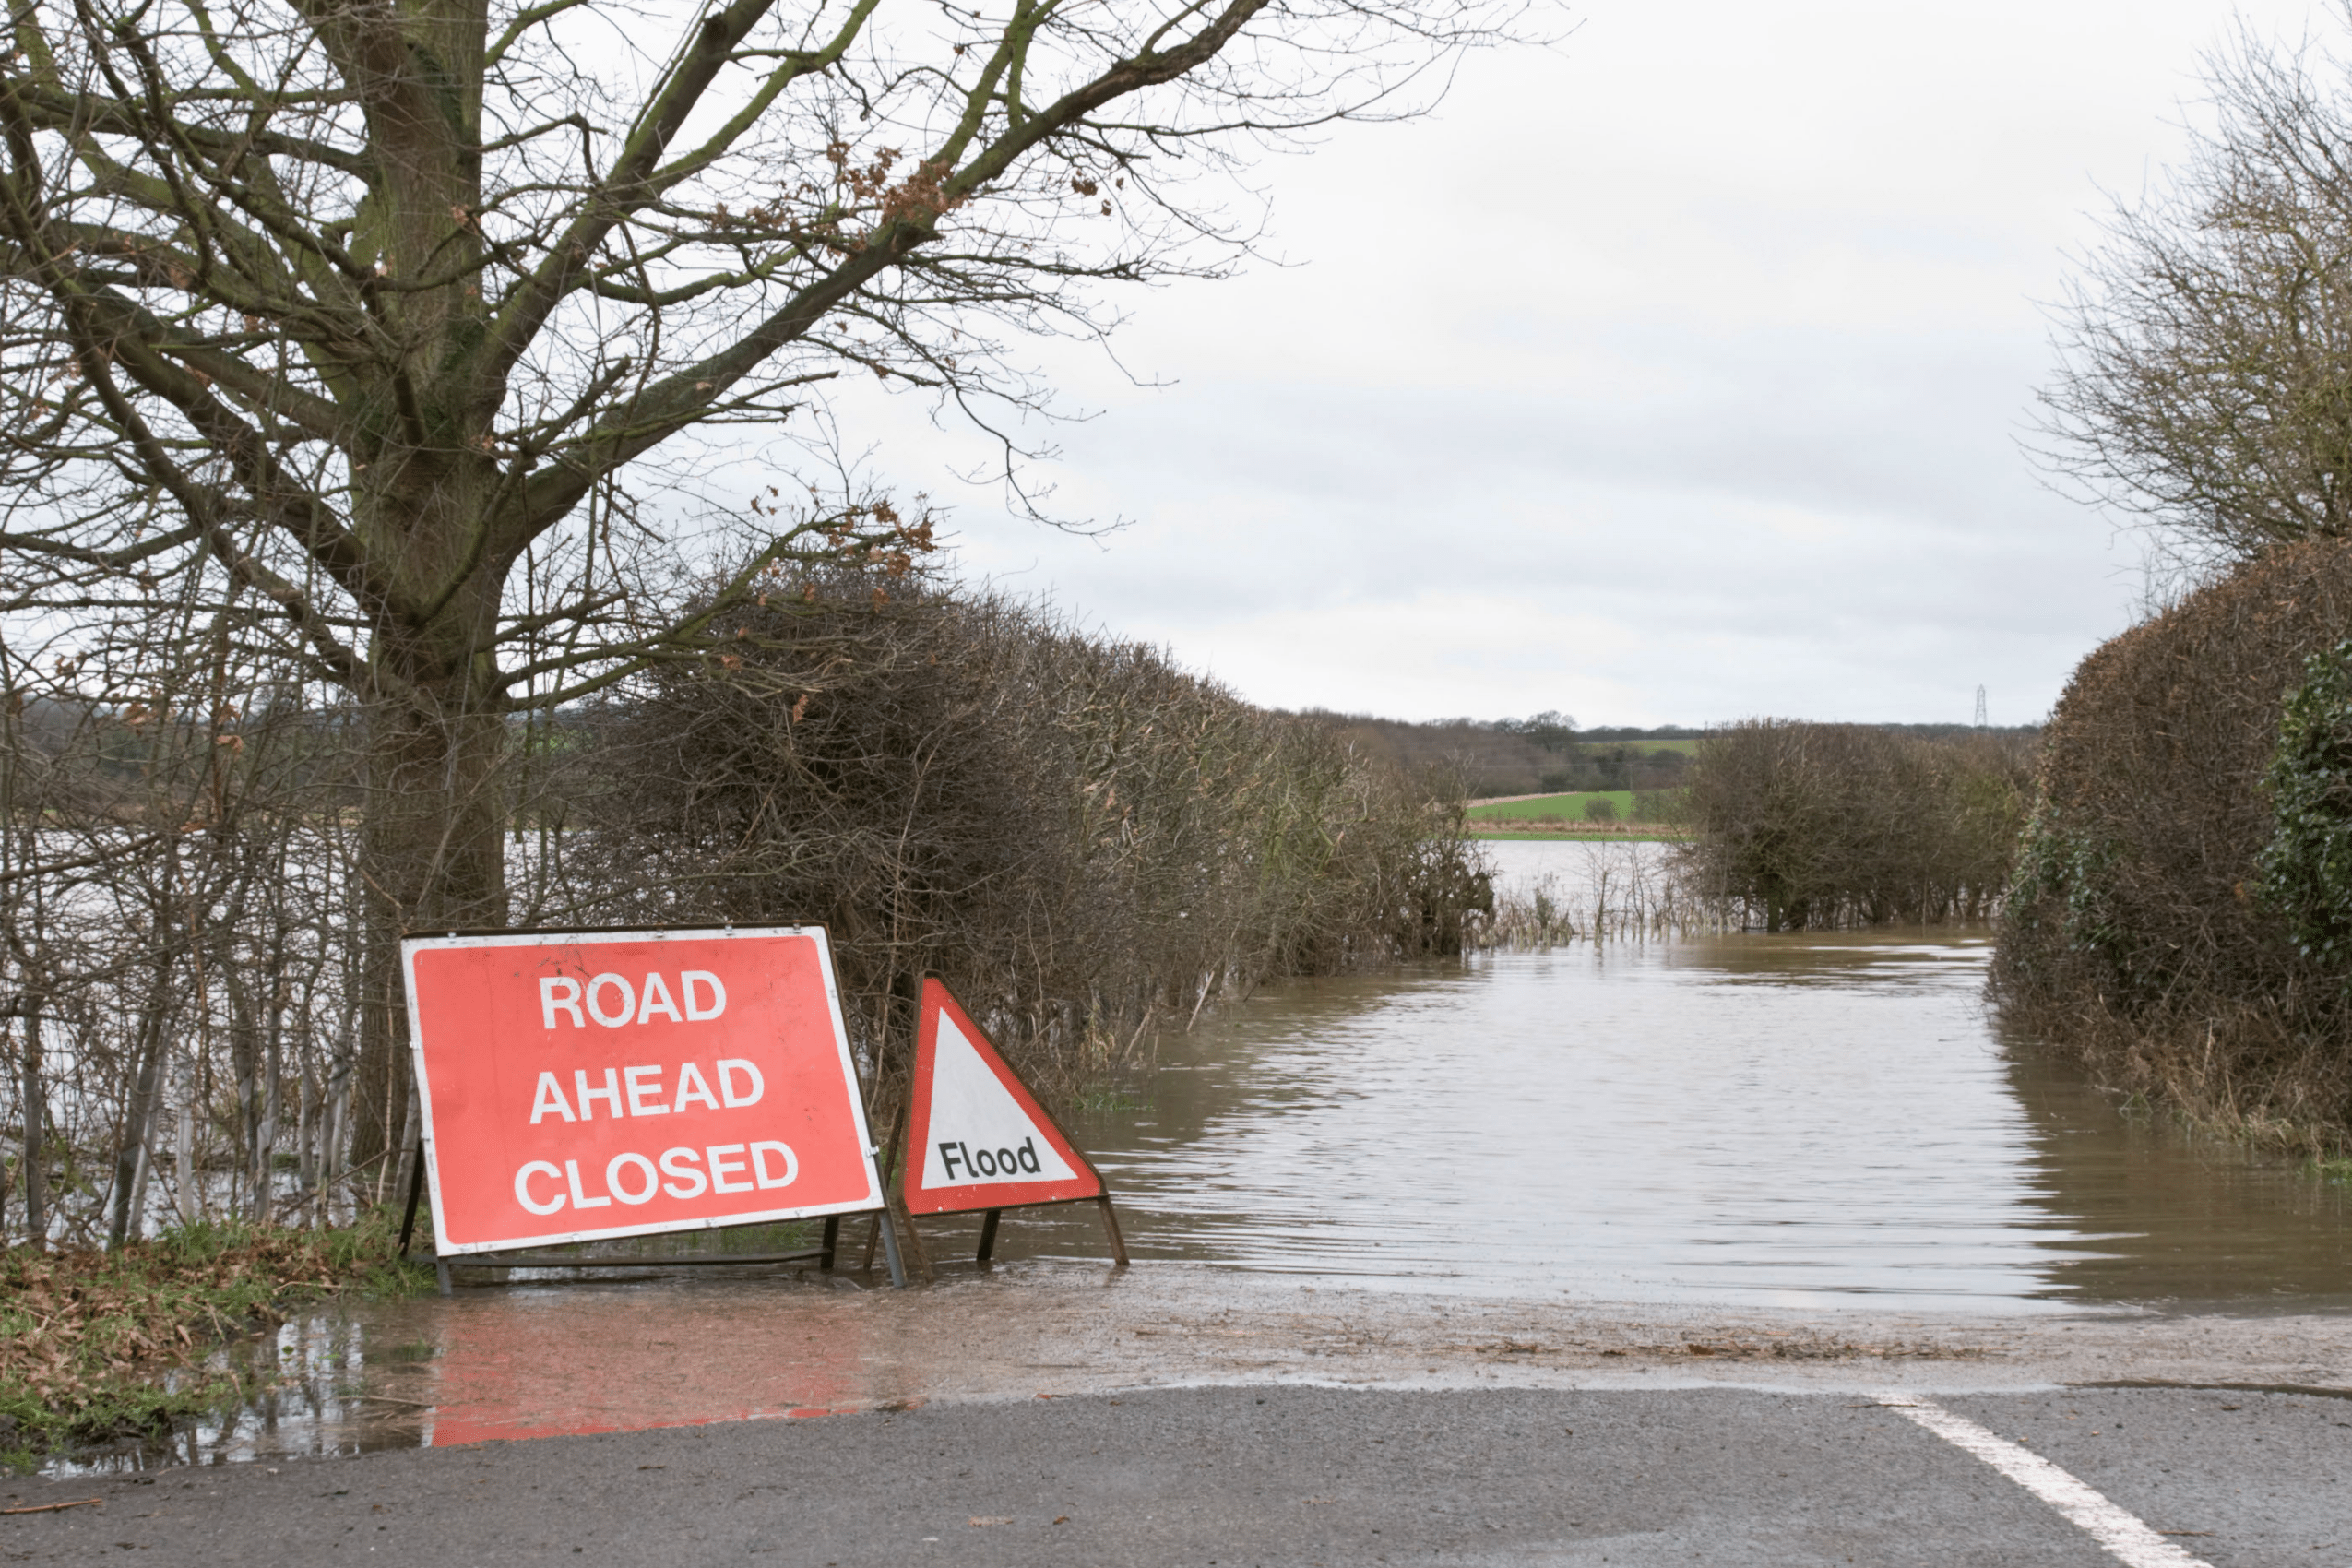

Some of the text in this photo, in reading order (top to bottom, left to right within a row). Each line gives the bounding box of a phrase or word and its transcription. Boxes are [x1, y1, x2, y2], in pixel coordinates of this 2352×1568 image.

[540, 970, 726, 1029] ROAD
[530, 1058, 766, 1124] AHEAD
[515, 1140, 798, 1215] CLOSED
[939, 1137, 1040, 1179] Flood
